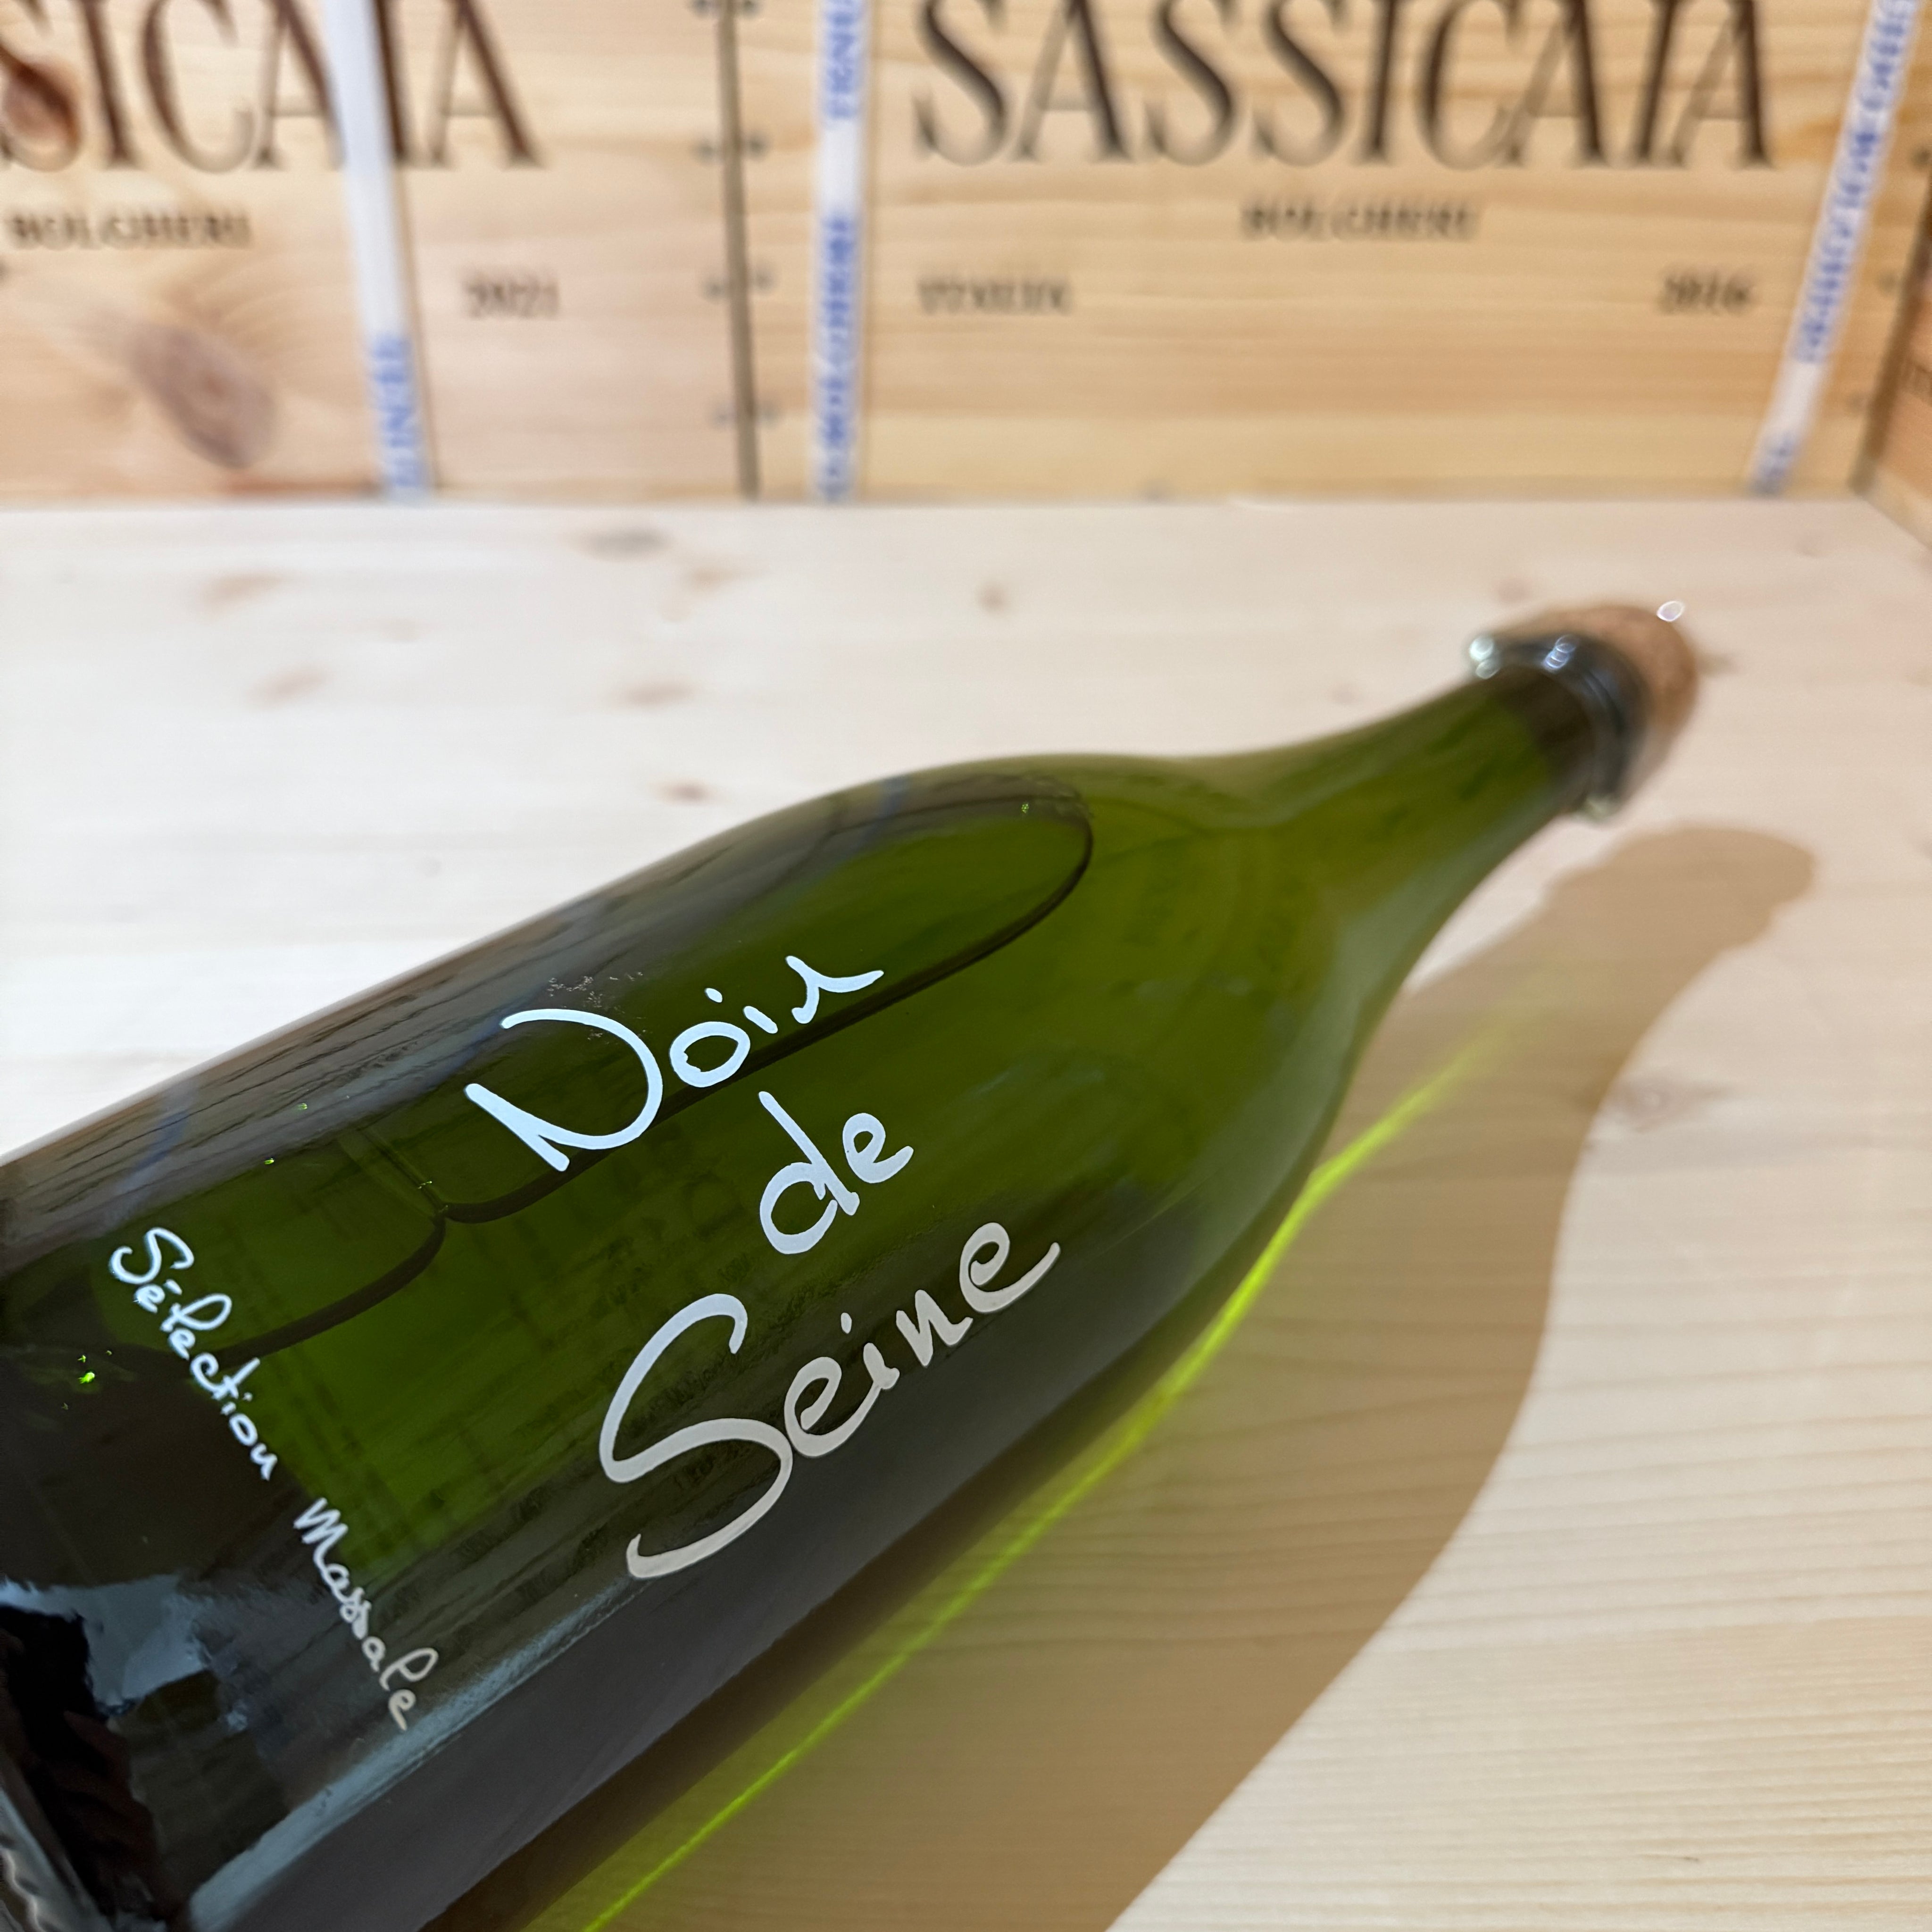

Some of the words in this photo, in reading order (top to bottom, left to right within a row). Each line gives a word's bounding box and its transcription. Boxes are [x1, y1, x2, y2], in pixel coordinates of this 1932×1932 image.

[910, 0, 1777, 170] SASSICAIA
[464, 955, 885, 1172] Noir
[758, 1091, 915, 1255] de
[109, 1227, 278, 1480] Sélection
[293, 1497, 438, 1732] Massale
[599, 1222, 1061, 1579] Seine
